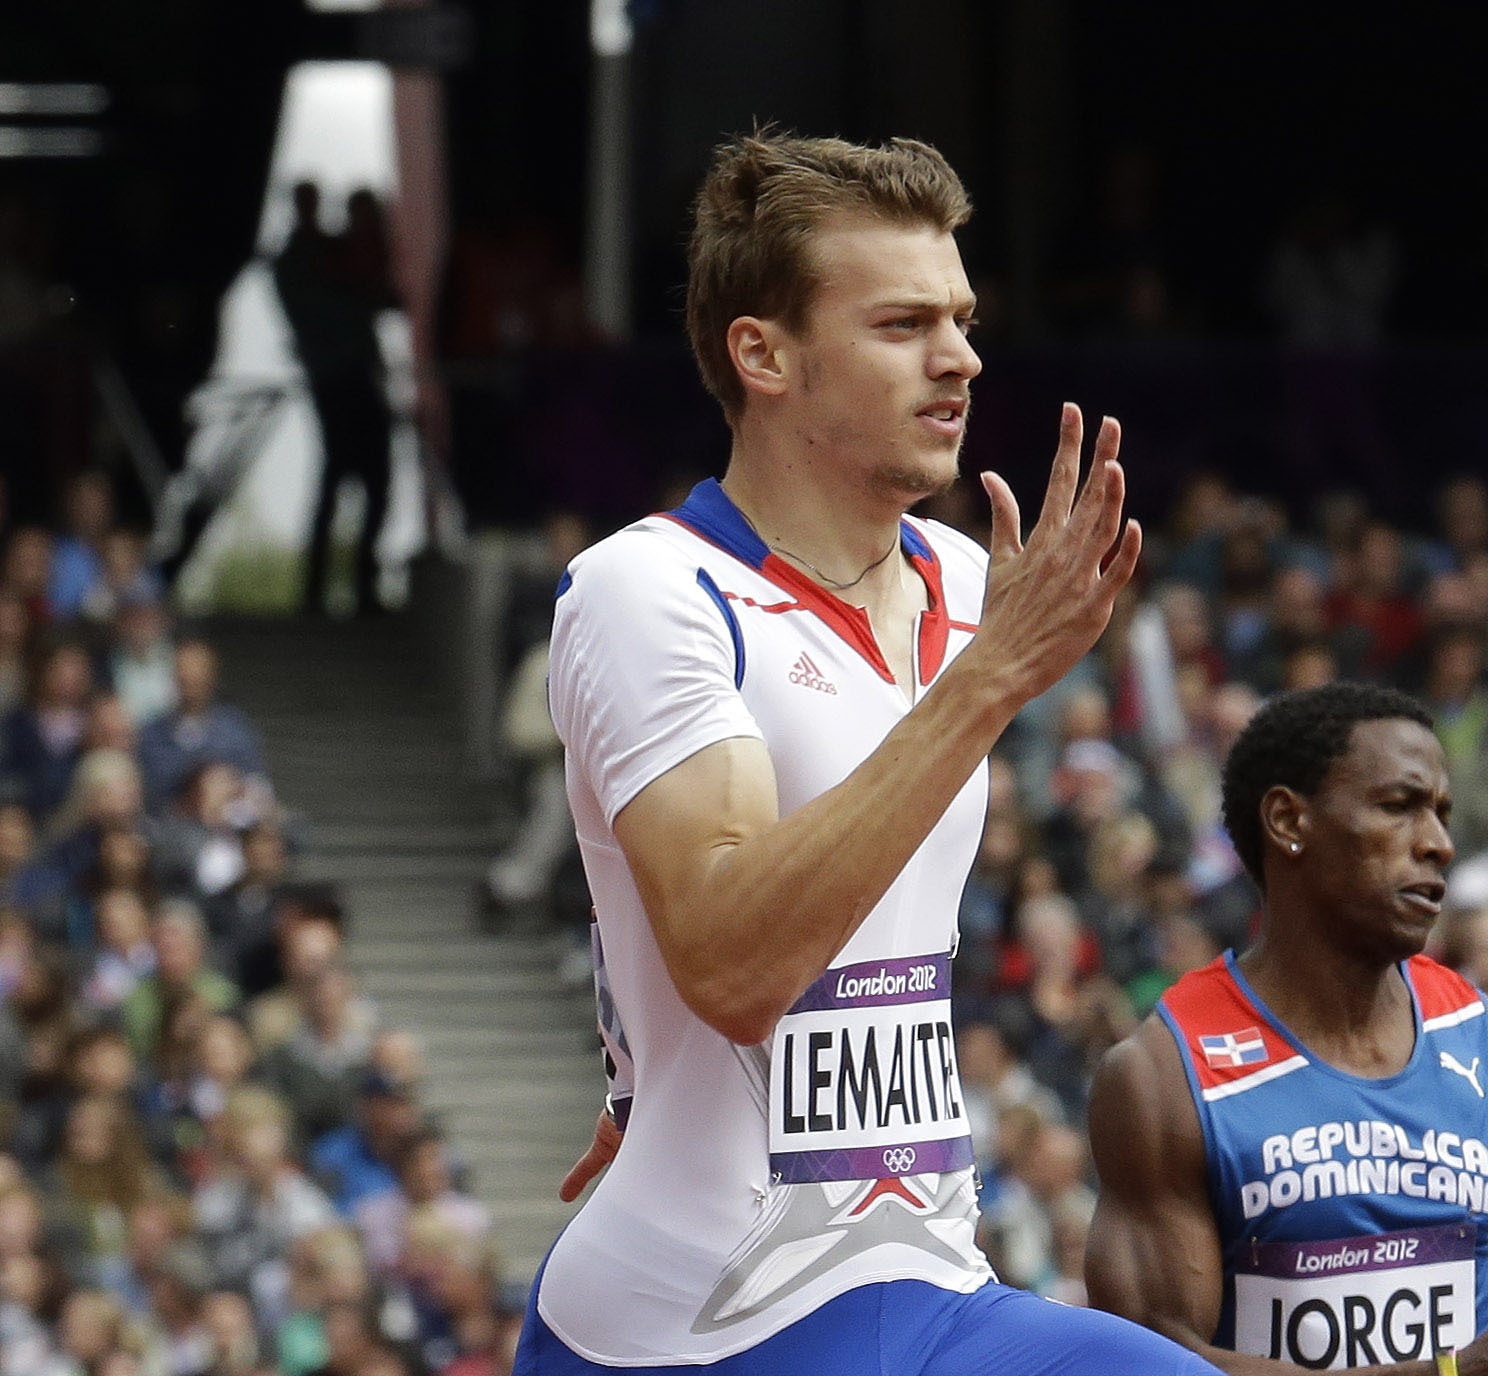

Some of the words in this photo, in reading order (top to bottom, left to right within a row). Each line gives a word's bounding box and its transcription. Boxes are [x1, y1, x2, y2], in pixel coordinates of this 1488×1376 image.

[788, 671, 838, 695] adidas
[835, 968, 907, 998] London
[907, 964, 937, 993] 2012
[1296, 1244, 1370, 1273] London
[1373, 1238, 1420, 1262] 2012
[1268, 1284, 1453, 1370] JORGE
